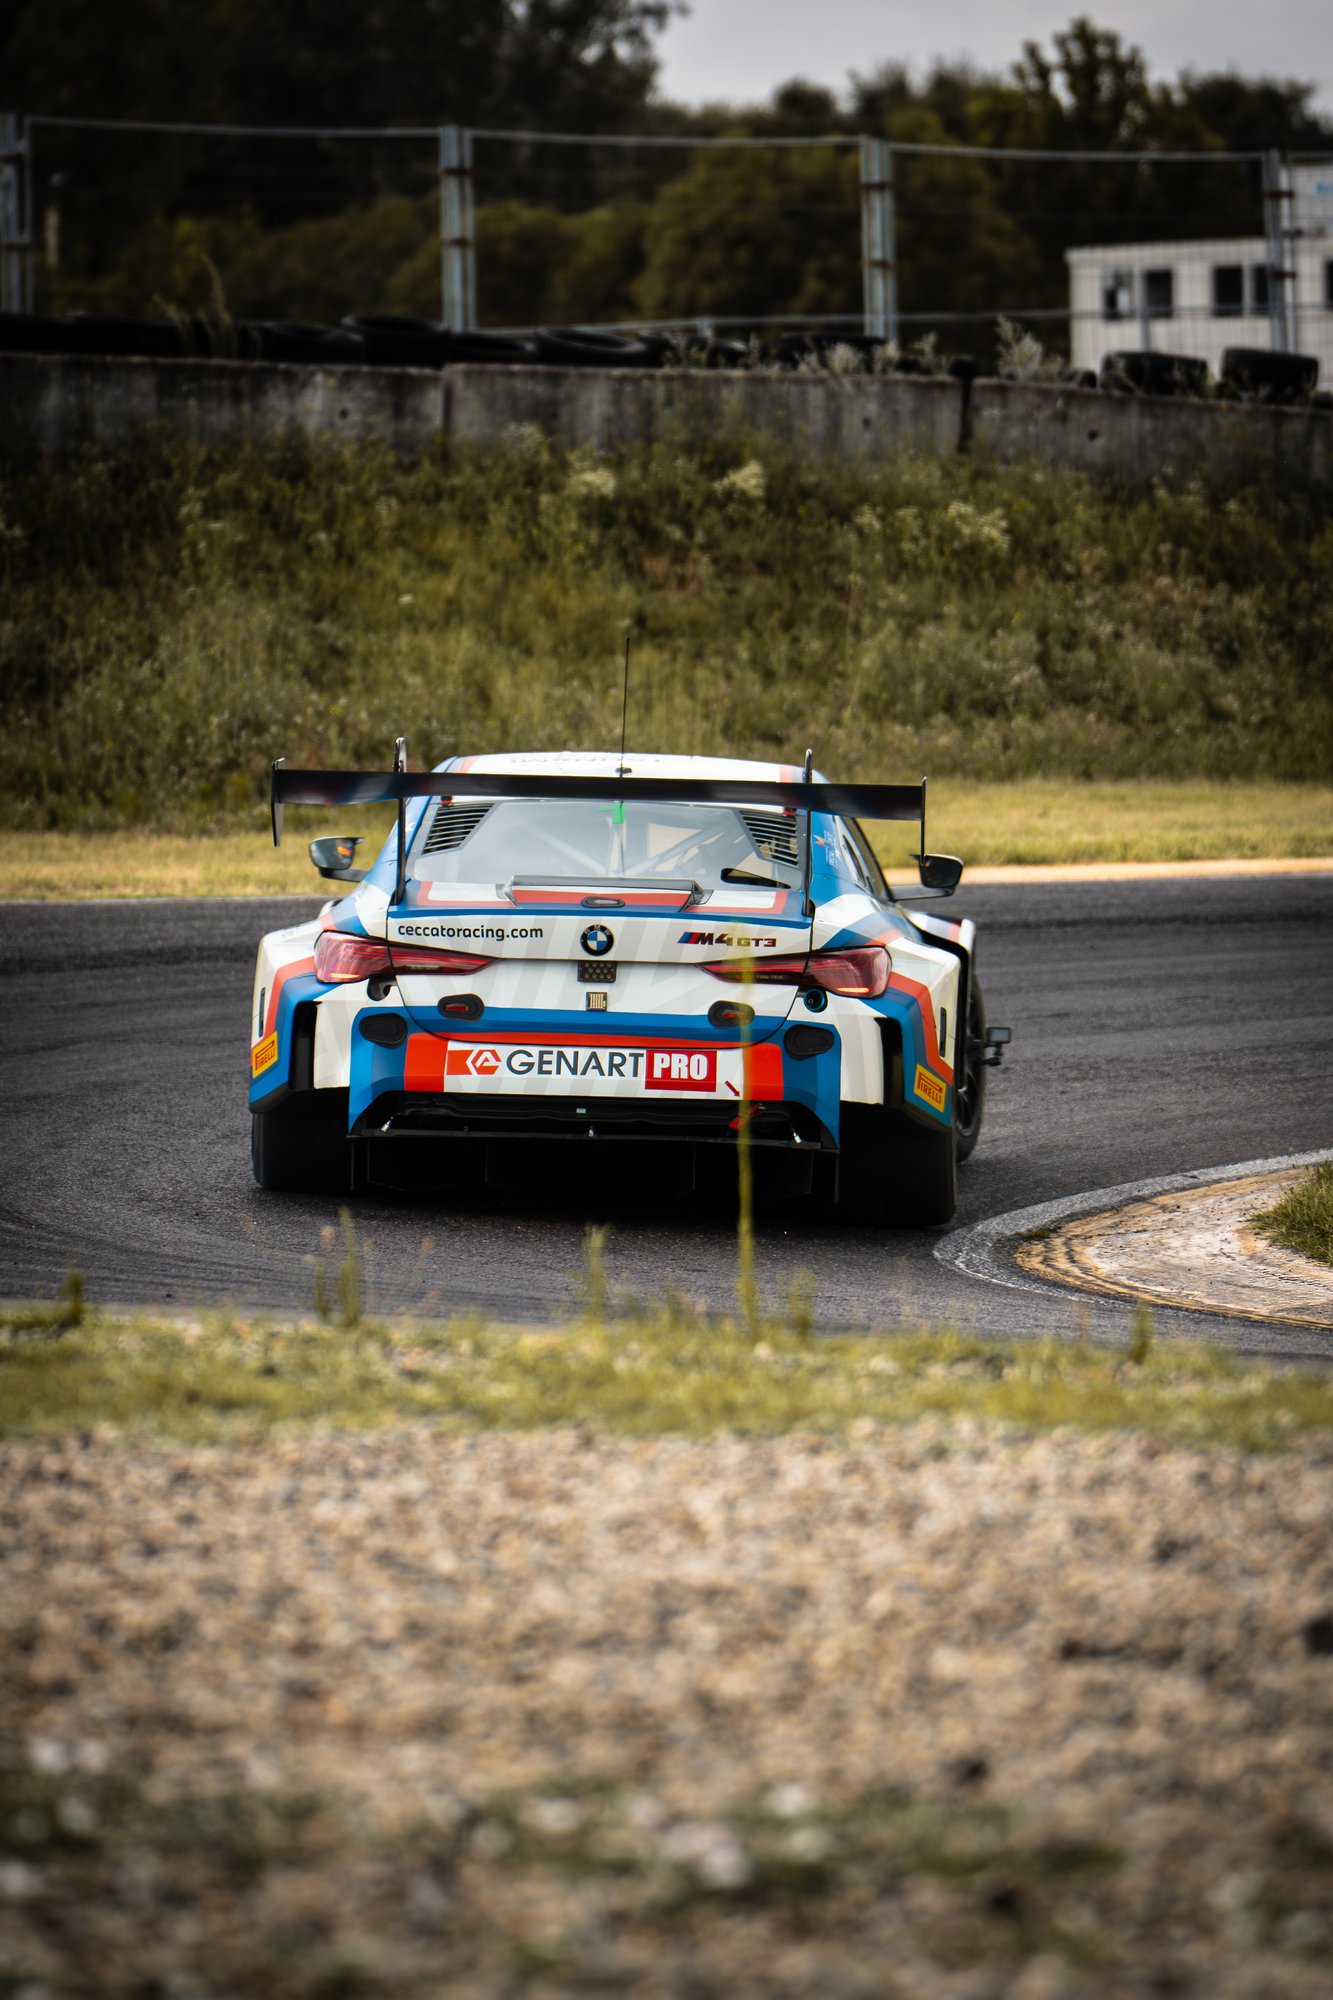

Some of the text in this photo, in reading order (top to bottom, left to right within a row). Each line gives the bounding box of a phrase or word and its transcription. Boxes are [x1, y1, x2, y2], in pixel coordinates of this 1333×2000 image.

[397, 924, 544, 941] ceccatoracing.com
[696, 931, 777, 947] M4 GT3
[255, 1039, 275, 1071] PIRELLI
[506, 1049, 709, 1081] GENART PRO
[917, 1071, 943, 1105] PIRELLI
